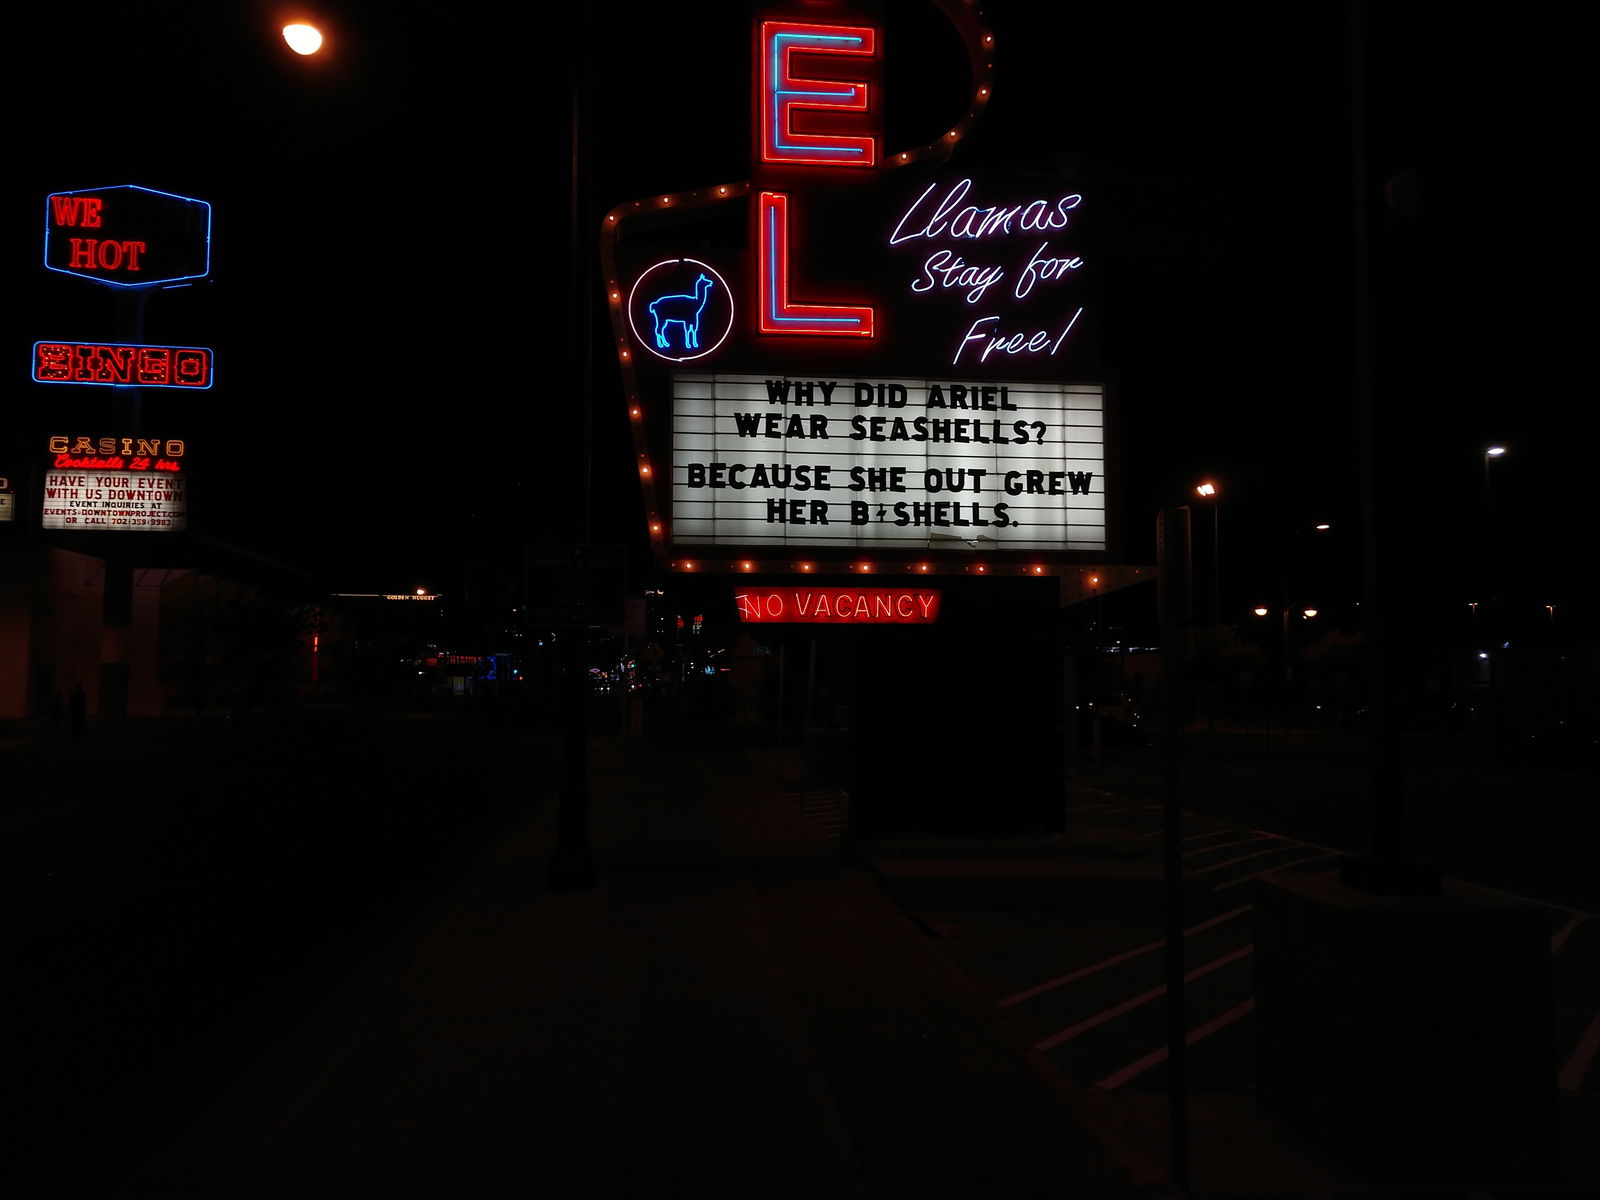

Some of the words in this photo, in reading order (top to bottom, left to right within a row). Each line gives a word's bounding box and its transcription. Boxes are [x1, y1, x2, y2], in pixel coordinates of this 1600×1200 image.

[889, 178, 1082, 245] Llamas
[911, 249, 1005, 304] Stay
[1015, 241, 1084, 299] for
[953, 307, 1083, 365] Free!
[38, 344, 208, 385] BINGO
[765, 379, 838, 407] WHY
[854, 381, 908, 409] DID
[927, 383, 1018, 412] ARIEL
[734, 412, 829, 440] WEAR
[849, 415, 1048, 446] SEASHELLS?
[49, 436, 185, 457] CASINO
[54, 453, 124, 469] Cocktails
[129, 456, 151, 470] 24
[49, 475, 86, 487] HAVE
[96, 477, 129, 488] YOUR
[138, 478, 183, 489] EVENT
[687, 462, 832, 492] BECAUSE
[848, 465, 907, 494] SHE
[923, 468, 987, 495] OUT
[1004, 470, 1093, 497] GREW
[46, 487, 79, 499] WITH
[85, 488, 103, 500] US
[108, 489, 183, 502] DOWNTOWN
[69, 500, 99, 508] EVENT
[101, 501, 145, 509] INQUIRIES
[151, 502, 163, 510] AT
[84, 517, 107, 525] CALL
[766, 498, 830, 526] HER
[741, 594, 784, 619] NO
[795, 593, 934, 618] VACANCY
